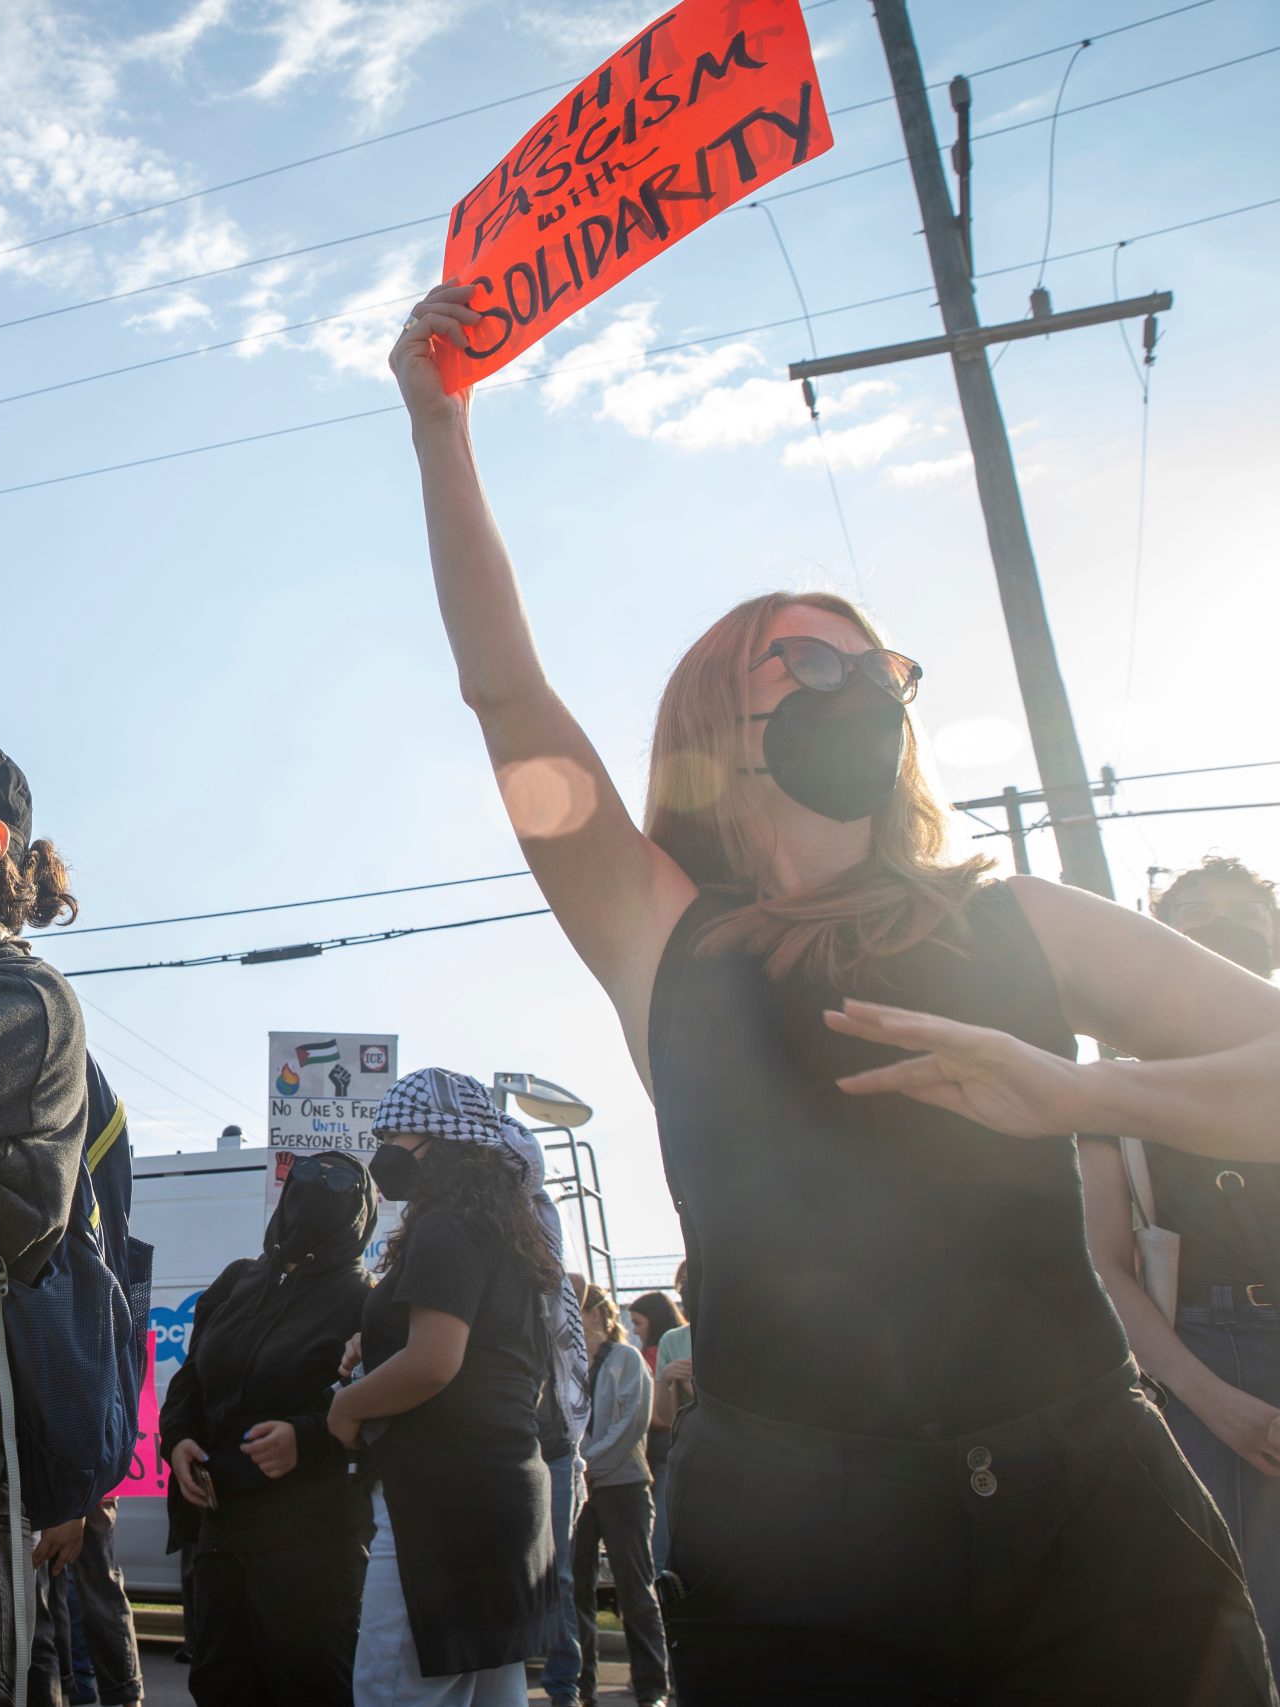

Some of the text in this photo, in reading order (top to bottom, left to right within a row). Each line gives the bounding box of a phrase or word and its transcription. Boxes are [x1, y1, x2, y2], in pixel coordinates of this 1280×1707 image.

[452, 14, 677, 240] FIGHT
[472, 31, 768, 263] FASCISM
[464, 81, 812, 360] SOLIDARITY
[538, 147, 659, 232] with
[365, 1052, 384, 1064] ICE
[270, 1127, 353, 1149] EVERYONE'S
[312, 1119, 350, 1132] UNTIL
